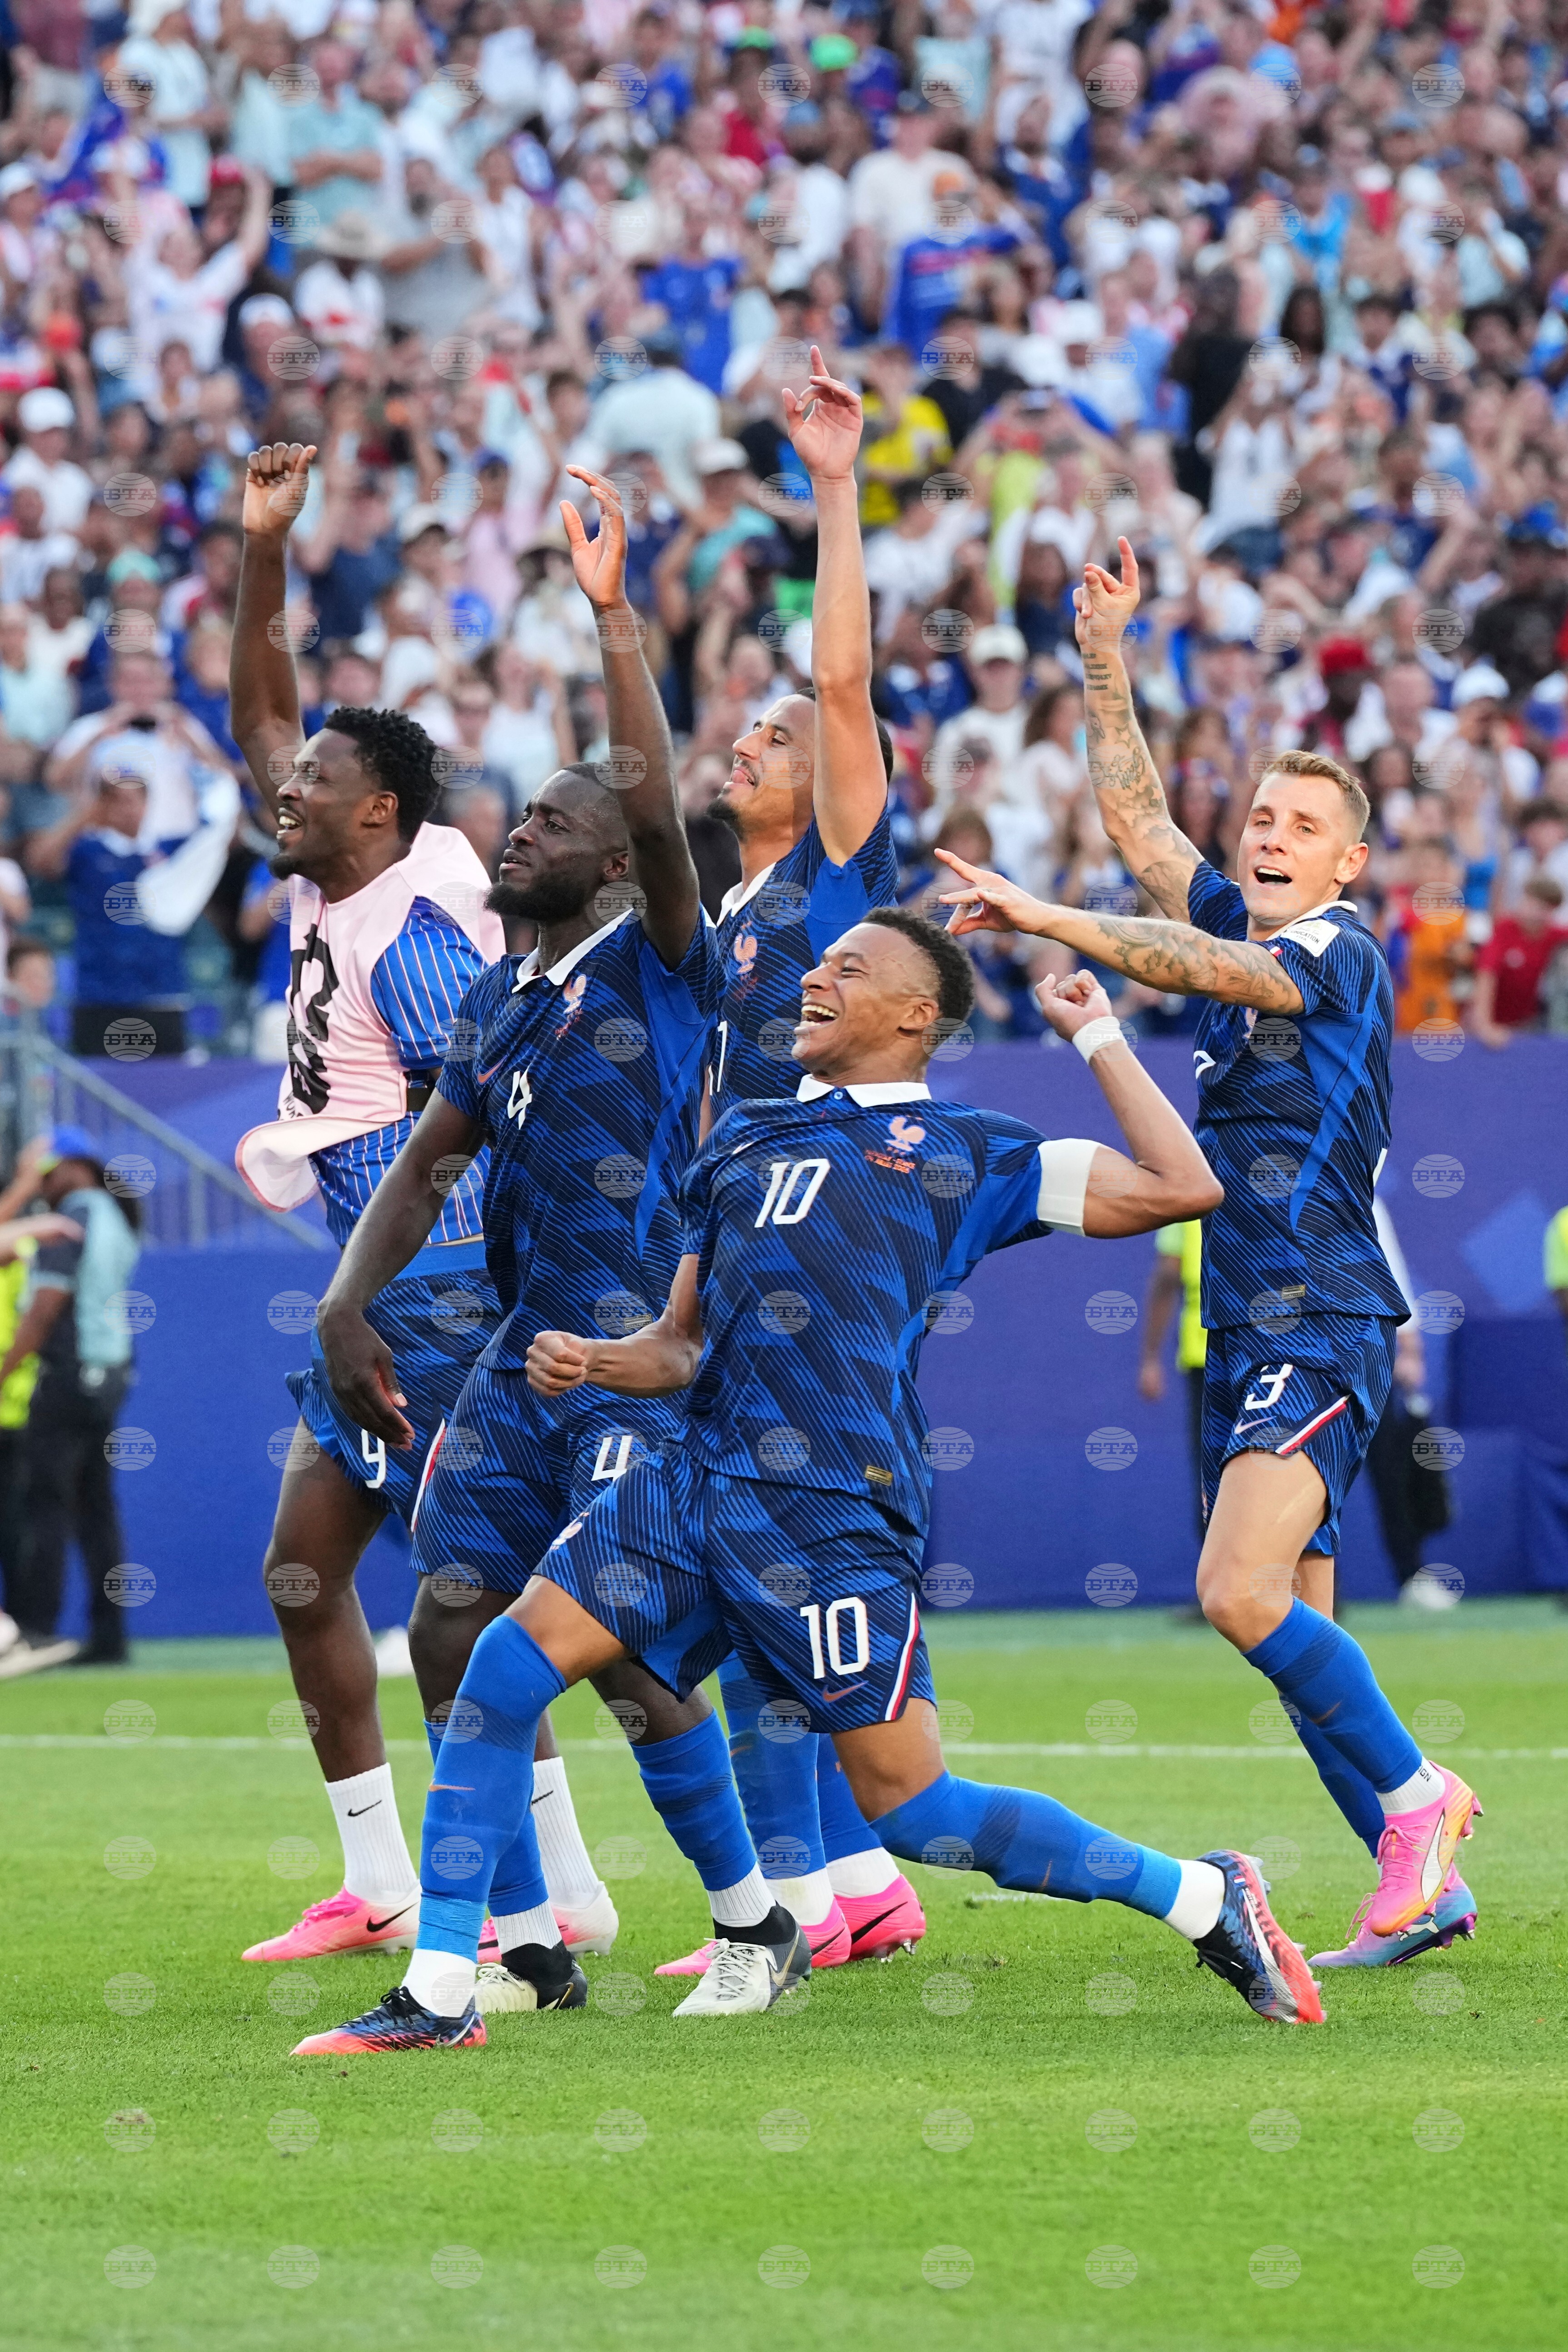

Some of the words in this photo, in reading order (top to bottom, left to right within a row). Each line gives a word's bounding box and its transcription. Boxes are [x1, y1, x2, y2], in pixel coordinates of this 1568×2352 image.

[508, 1068, 532, 1130] 4
[755, 1158, 830, 1228] 10
[1244, 1363, 1293, 1410] 3
[361, 1428, 386, 1489] 9
[591, 1435, 632, 1481] 4
[800, 1596, 870, 1679] 10
[1418, 1766, 1432, 1782] IGN
